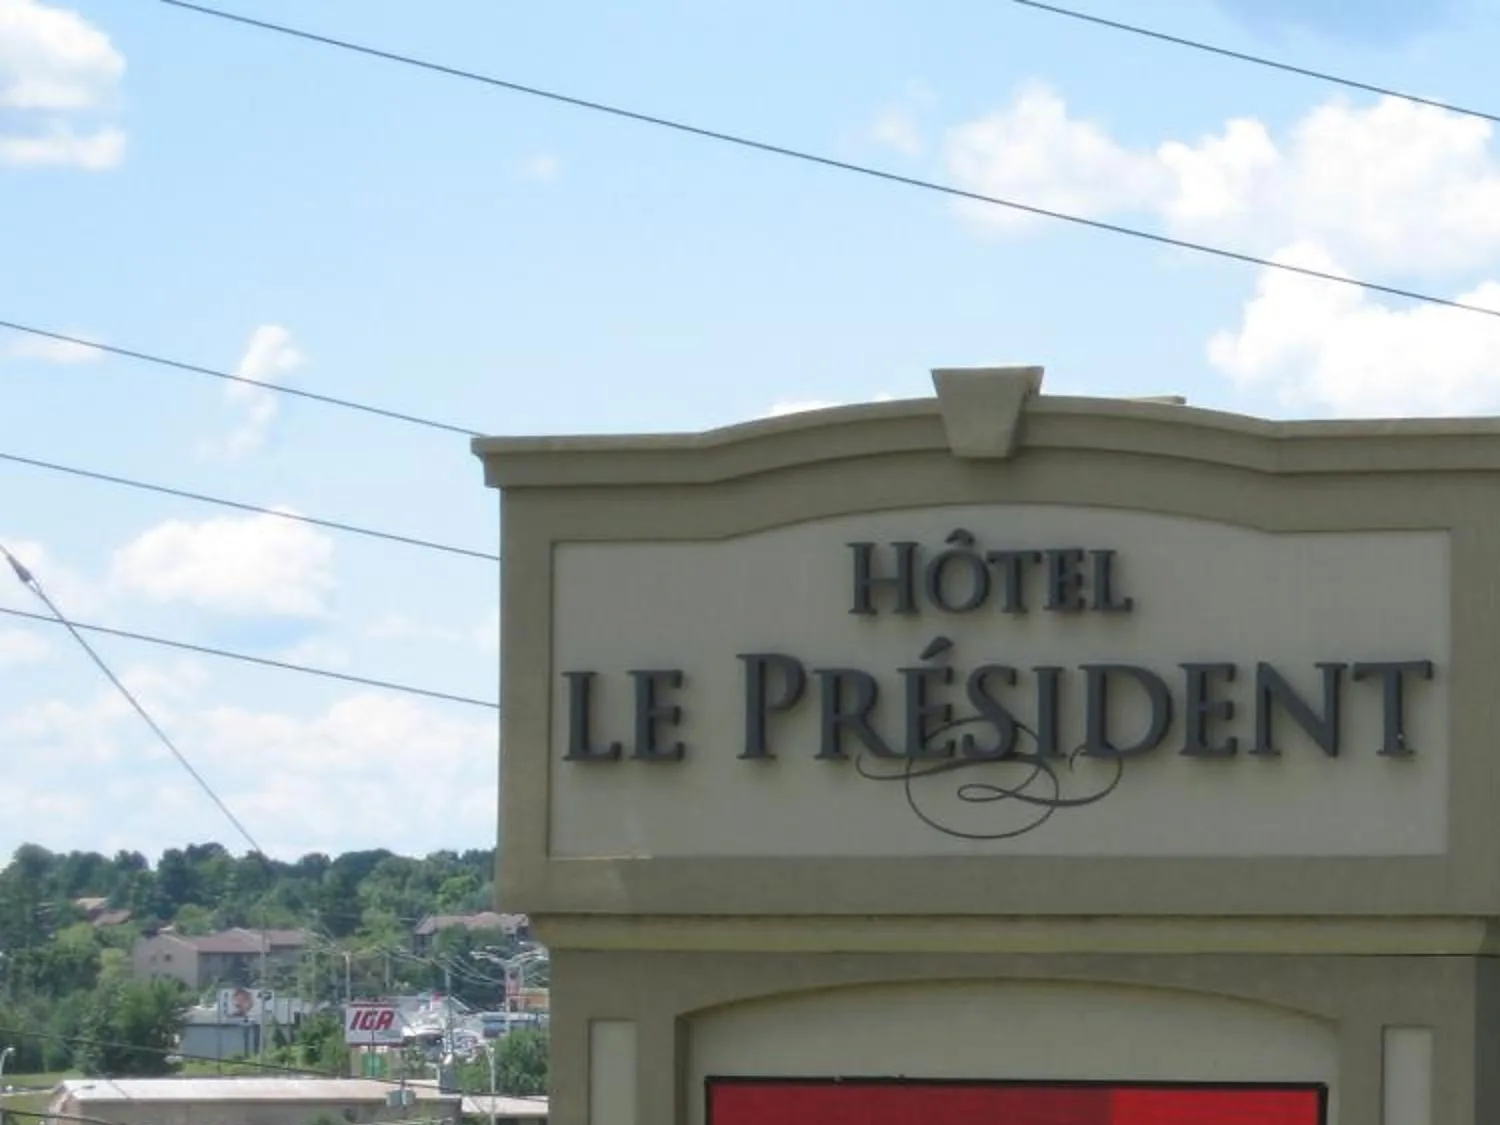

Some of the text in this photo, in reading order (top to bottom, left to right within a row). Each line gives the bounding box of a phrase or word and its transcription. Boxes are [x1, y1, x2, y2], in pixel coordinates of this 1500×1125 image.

[847, 528, 1134, 617] HÔTEL
[562, 635, 1434, 763] LE PRÉSIDENT
[349, 1010, 395, 1031] IGA
